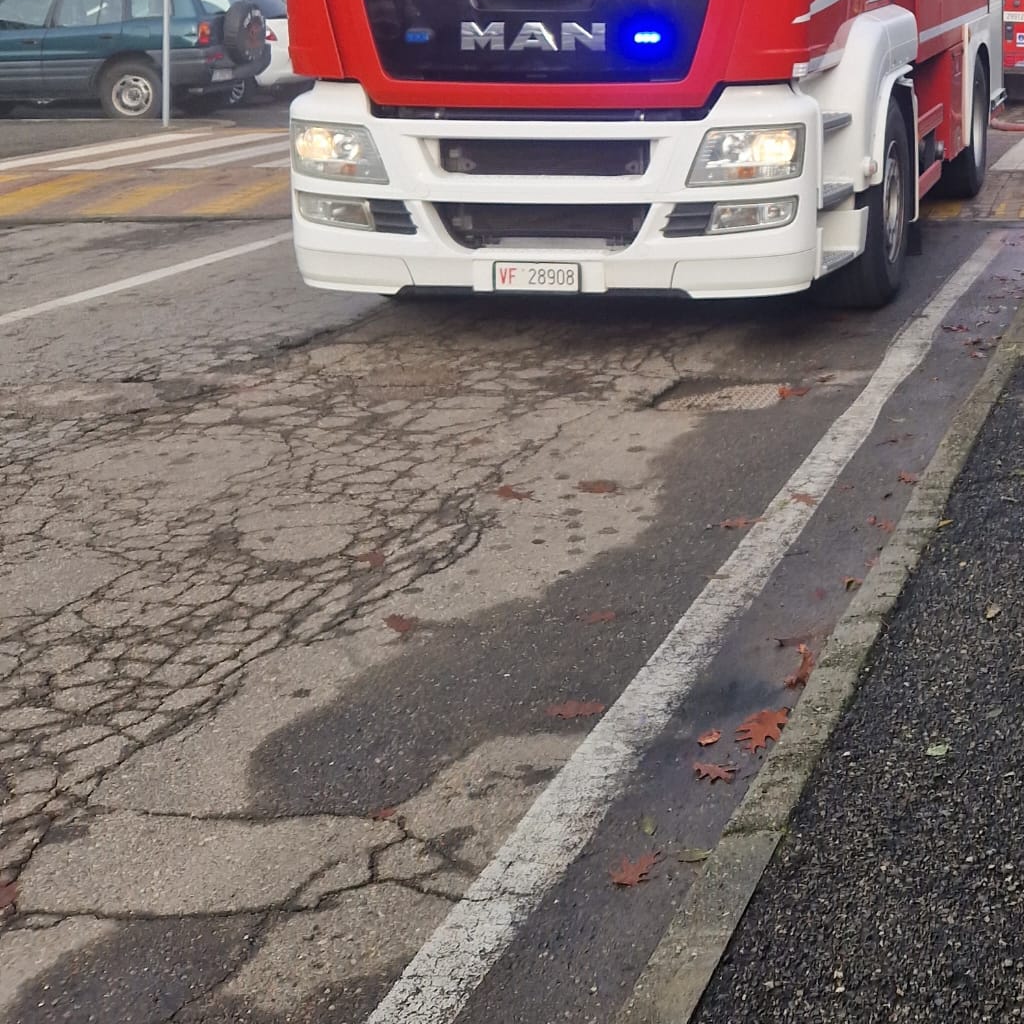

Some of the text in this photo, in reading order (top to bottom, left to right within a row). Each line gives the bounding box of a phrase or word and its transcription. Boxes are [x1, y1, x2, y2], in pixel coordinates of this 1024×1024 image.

[461, 22, 606, 51] MAN
[500, 268, 575, 285] VF 28908
